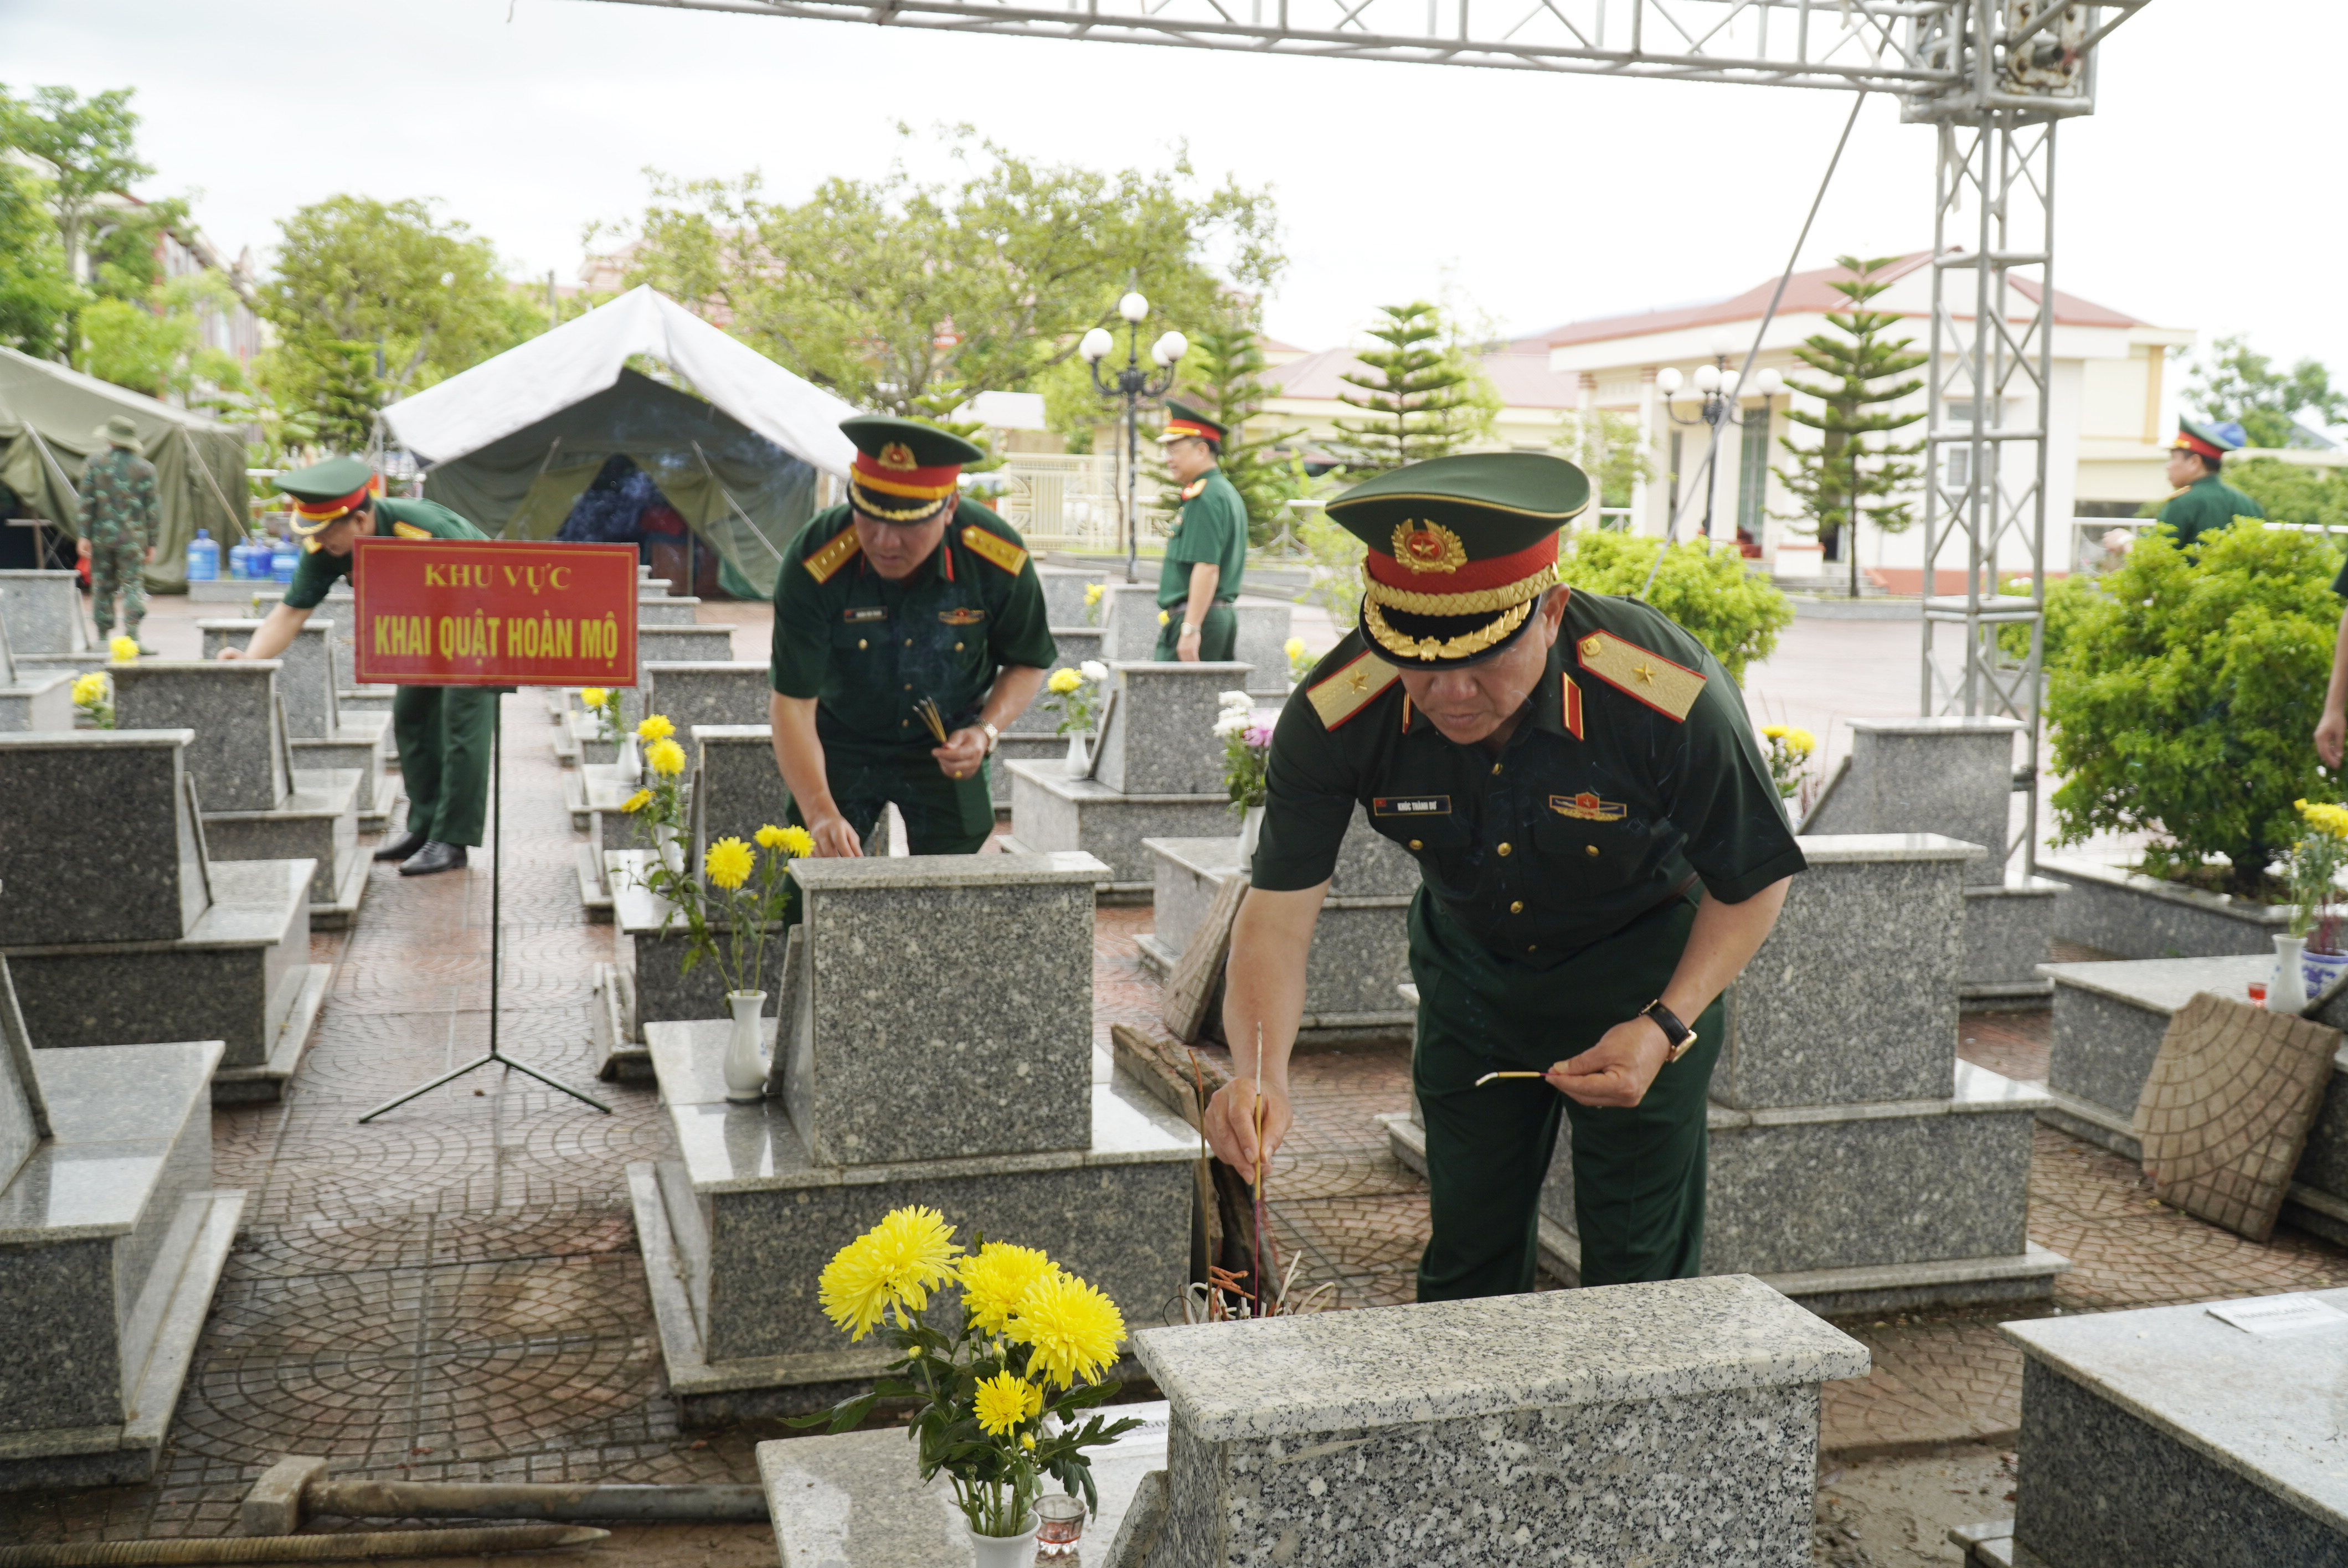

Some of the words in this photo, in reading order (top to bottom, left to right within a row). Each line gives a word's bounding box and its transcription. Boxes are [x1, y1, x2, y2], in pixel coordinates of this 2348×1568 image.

[425, 564, 493, 588] KHU
[503, 563, 571, 595] VỰC
[374, 615, 431, 656] KHAI
[439, 608, 500, 666] QUẬT
[508, 610, 573, 658] HOÀN
[580, 611, 618, 668] MỘ
